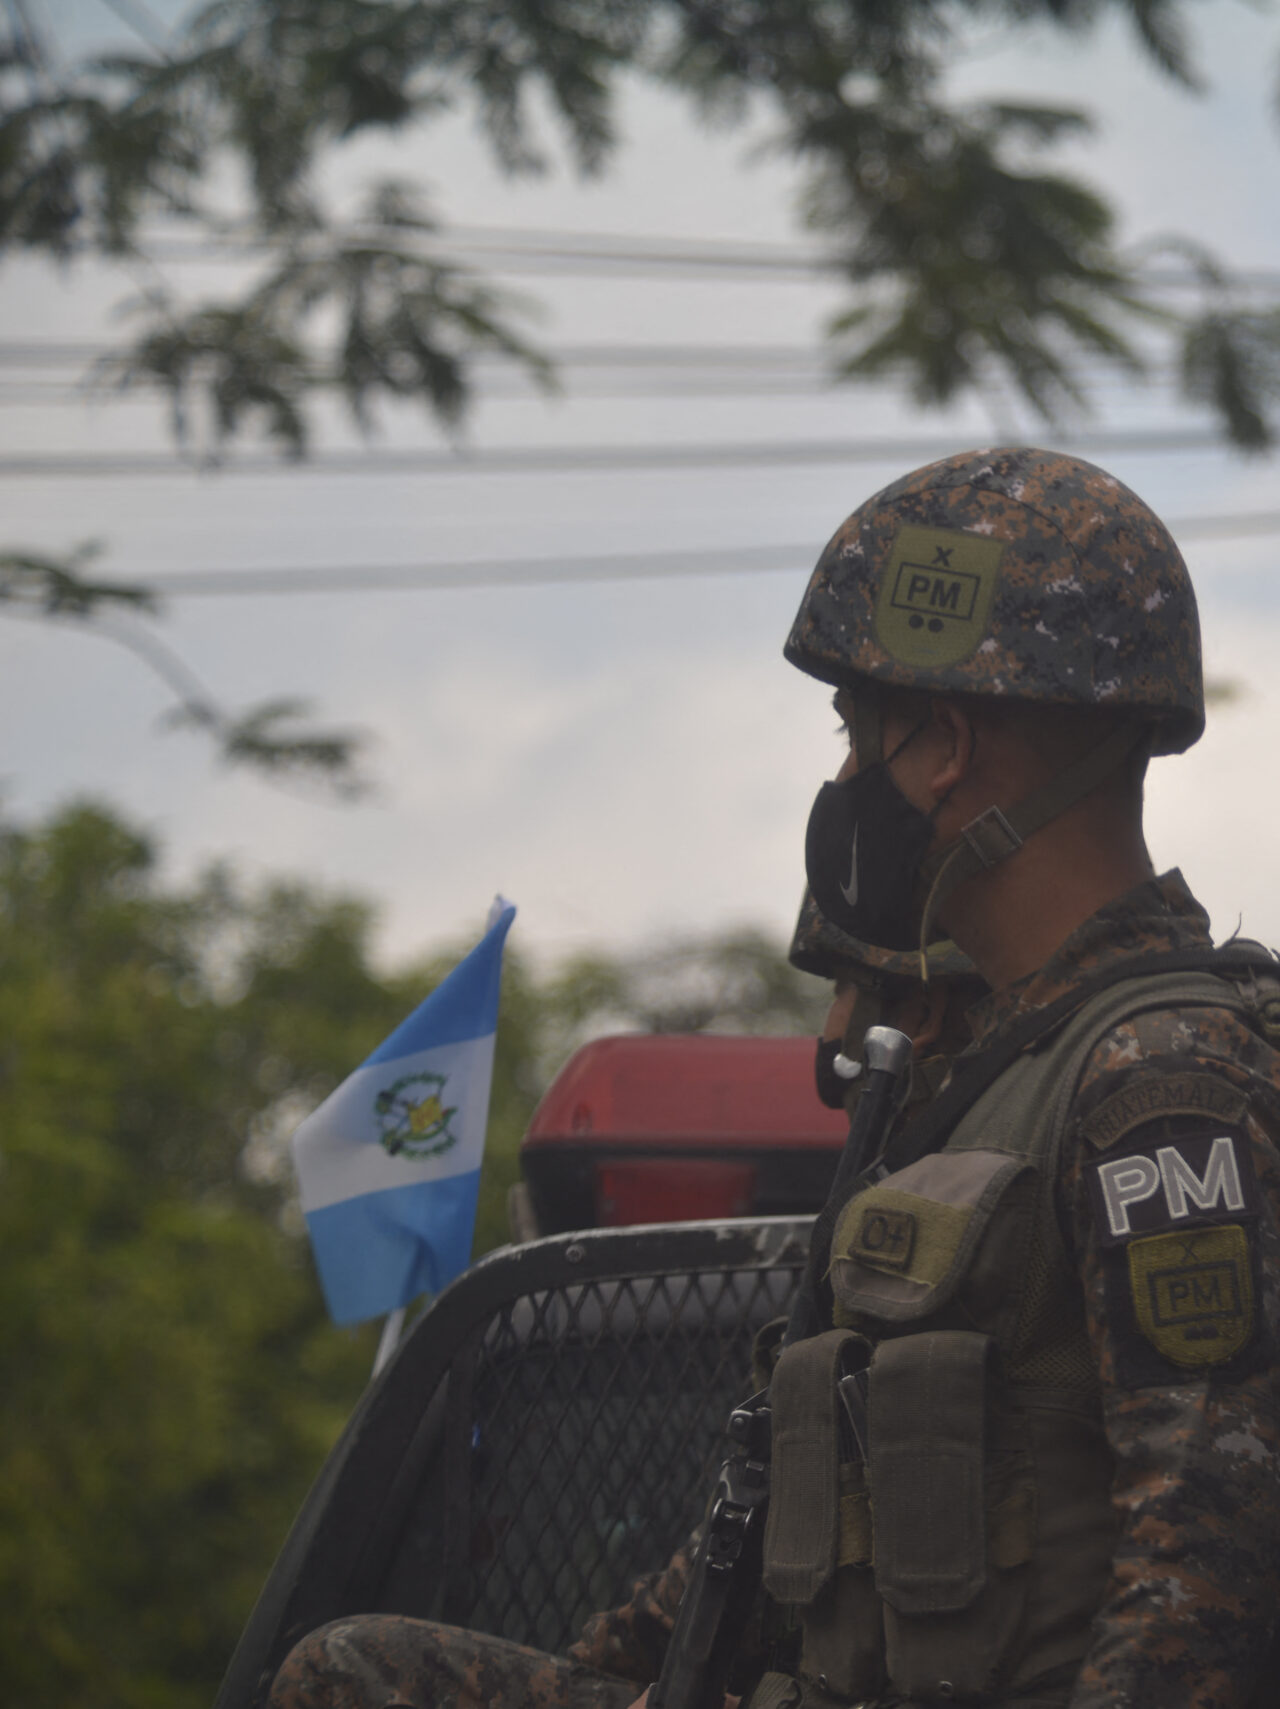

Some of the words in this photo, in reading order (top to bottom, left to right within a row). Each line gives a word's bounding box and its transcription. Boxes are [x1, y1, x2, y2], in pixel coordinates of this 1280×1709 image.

[907, 575, 962, 610] PM
[1097, 1137, 1246, 1236] PM
[1168, 1274, 1224, 1313] PM
